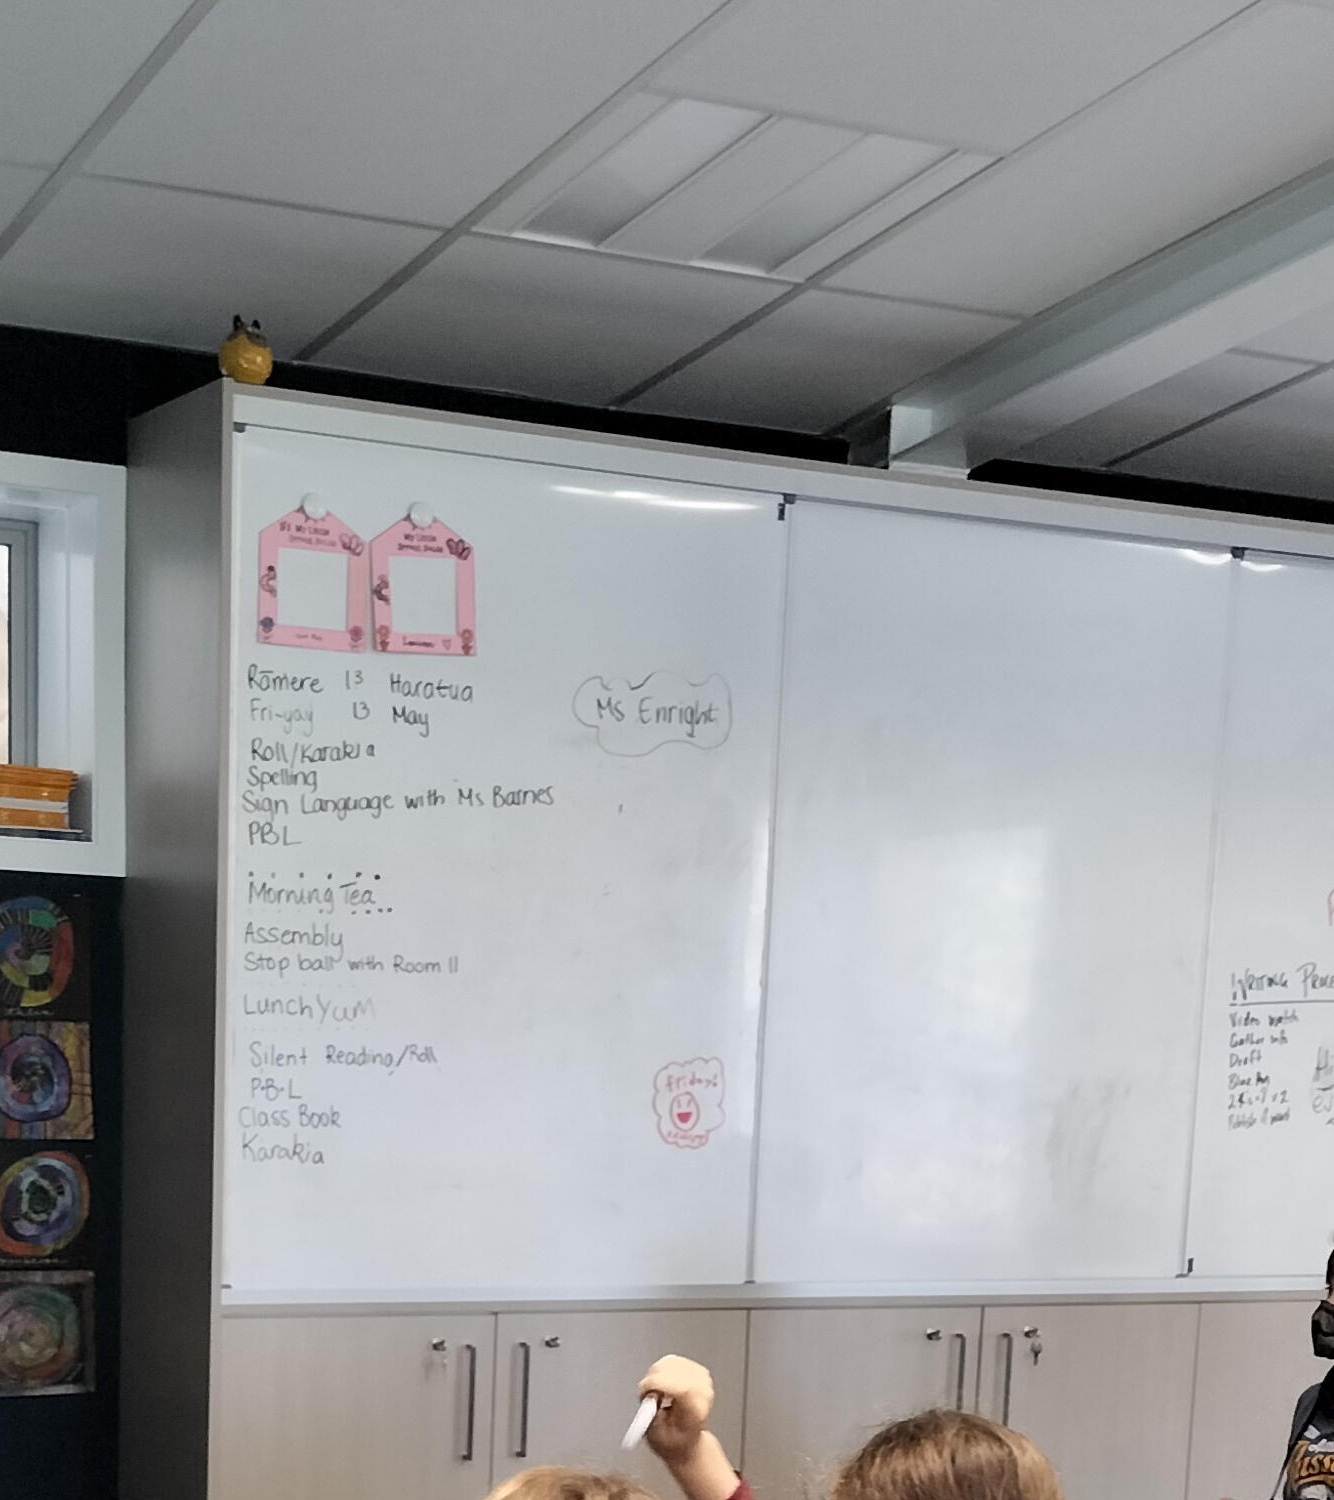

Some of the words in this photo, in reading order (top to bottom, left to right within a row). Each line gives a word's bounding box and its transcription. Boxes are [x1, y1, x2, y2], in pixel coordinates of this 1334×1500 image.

[346, 670, 364, 690] 13
[390, 673, 474, 702] Haratua
[392, 705, 430, 738] May
[597, 696, 625, 721] Ms
[639, 696, 718, 738] Enright
[247, 766, 317, 793] Spelling
[242, 790, 288, 821] Sign
[301, 794, 394, 820] Language
[405, 790, 445, 809] with
[458, 787, 484, 806] Ms
[493, 785, 554, 808] Barnes
[248, 821, 302, 846] PBL
[248, 881, 334, 914] Morning
[339, 881, 376, 906] Tea
[244, 921, 344, 962] Assembly
[244, 951, 290, 979] Stop
[348, 955, 384, 971] with
[393, 955, 441, 973] Room
[244, 994, 313, 1019] Lunch
[249, 1041, 308, 1068] Silent
[238, 1106, 291, 1128] Class
[298, 1103, 342, 1128] Book
[242, 1132, 325, 1164] Karakia
